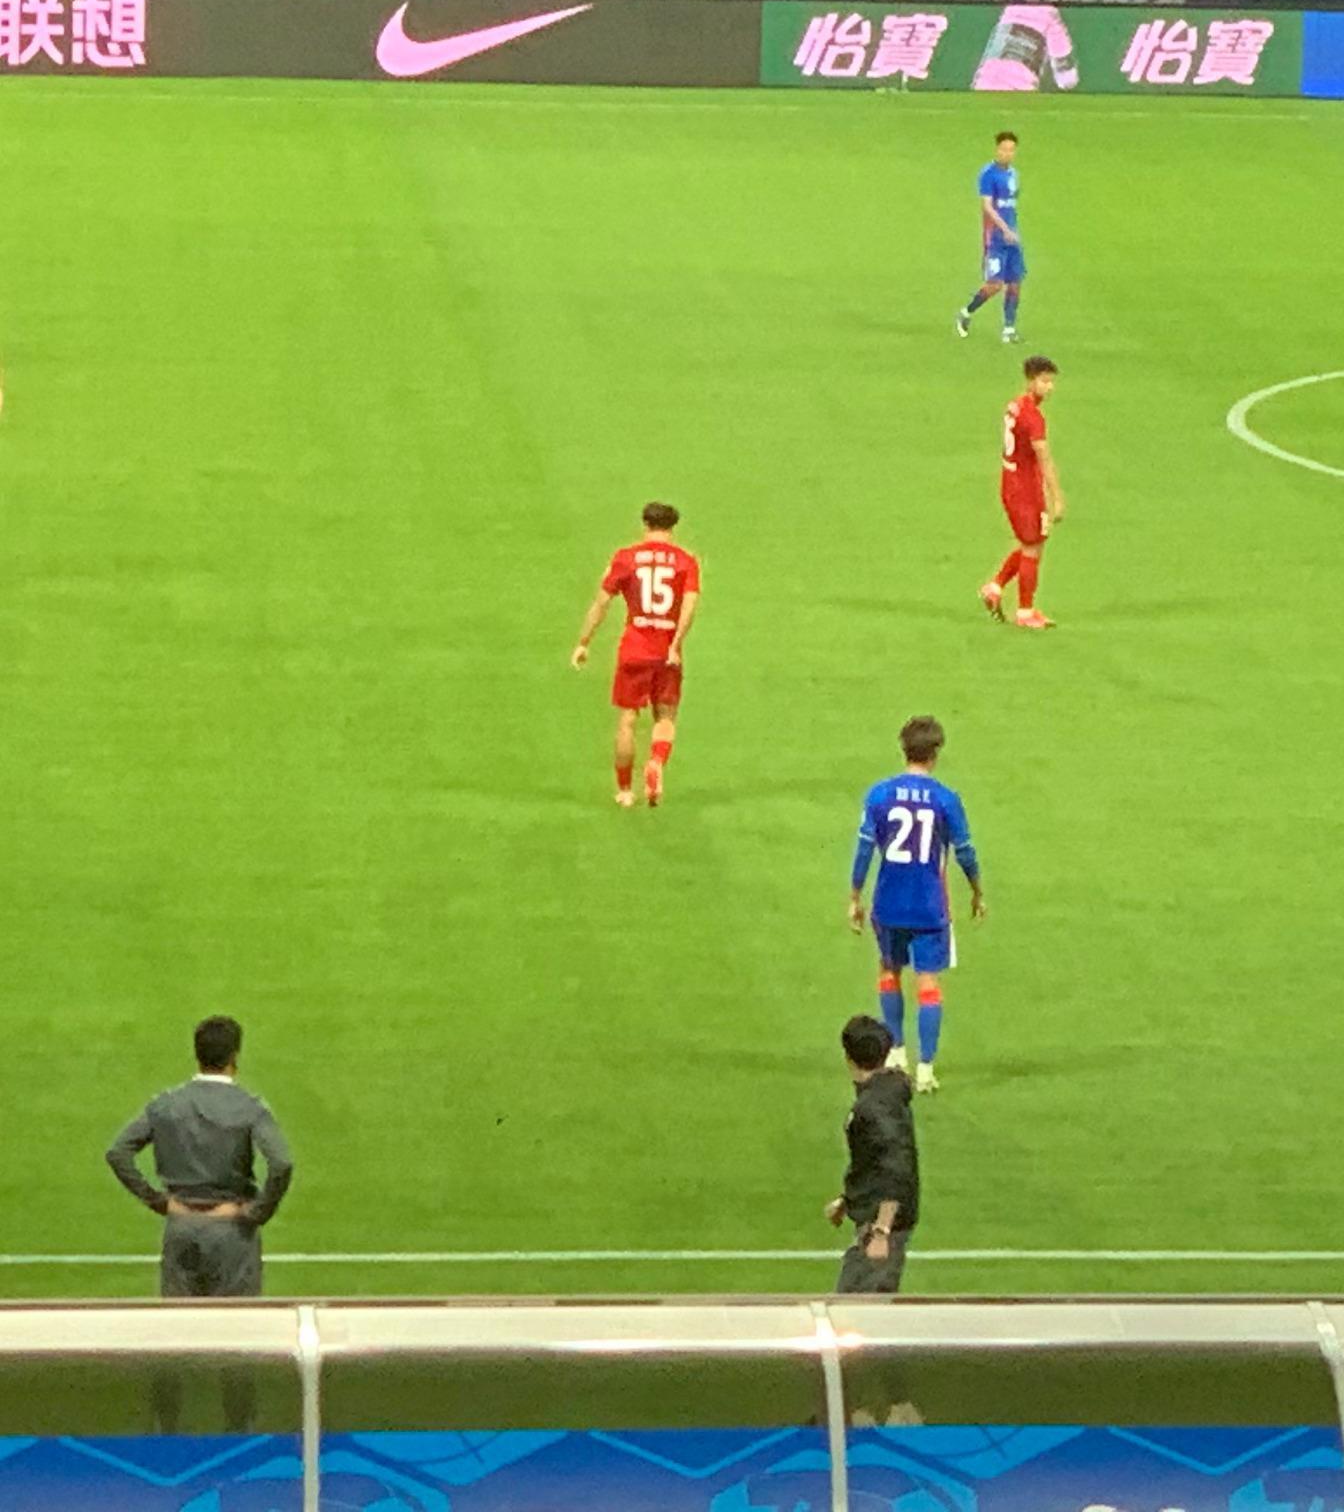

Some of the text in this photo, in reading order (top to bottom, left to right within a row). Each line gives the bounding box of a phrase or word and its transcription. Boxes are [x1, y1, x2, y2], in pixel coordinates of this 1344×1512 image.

[794, 11, 1274, 86] 怡寶 怡寶
[635, 565, 677, 616] 15
[885, 805, 937, 865] 21
